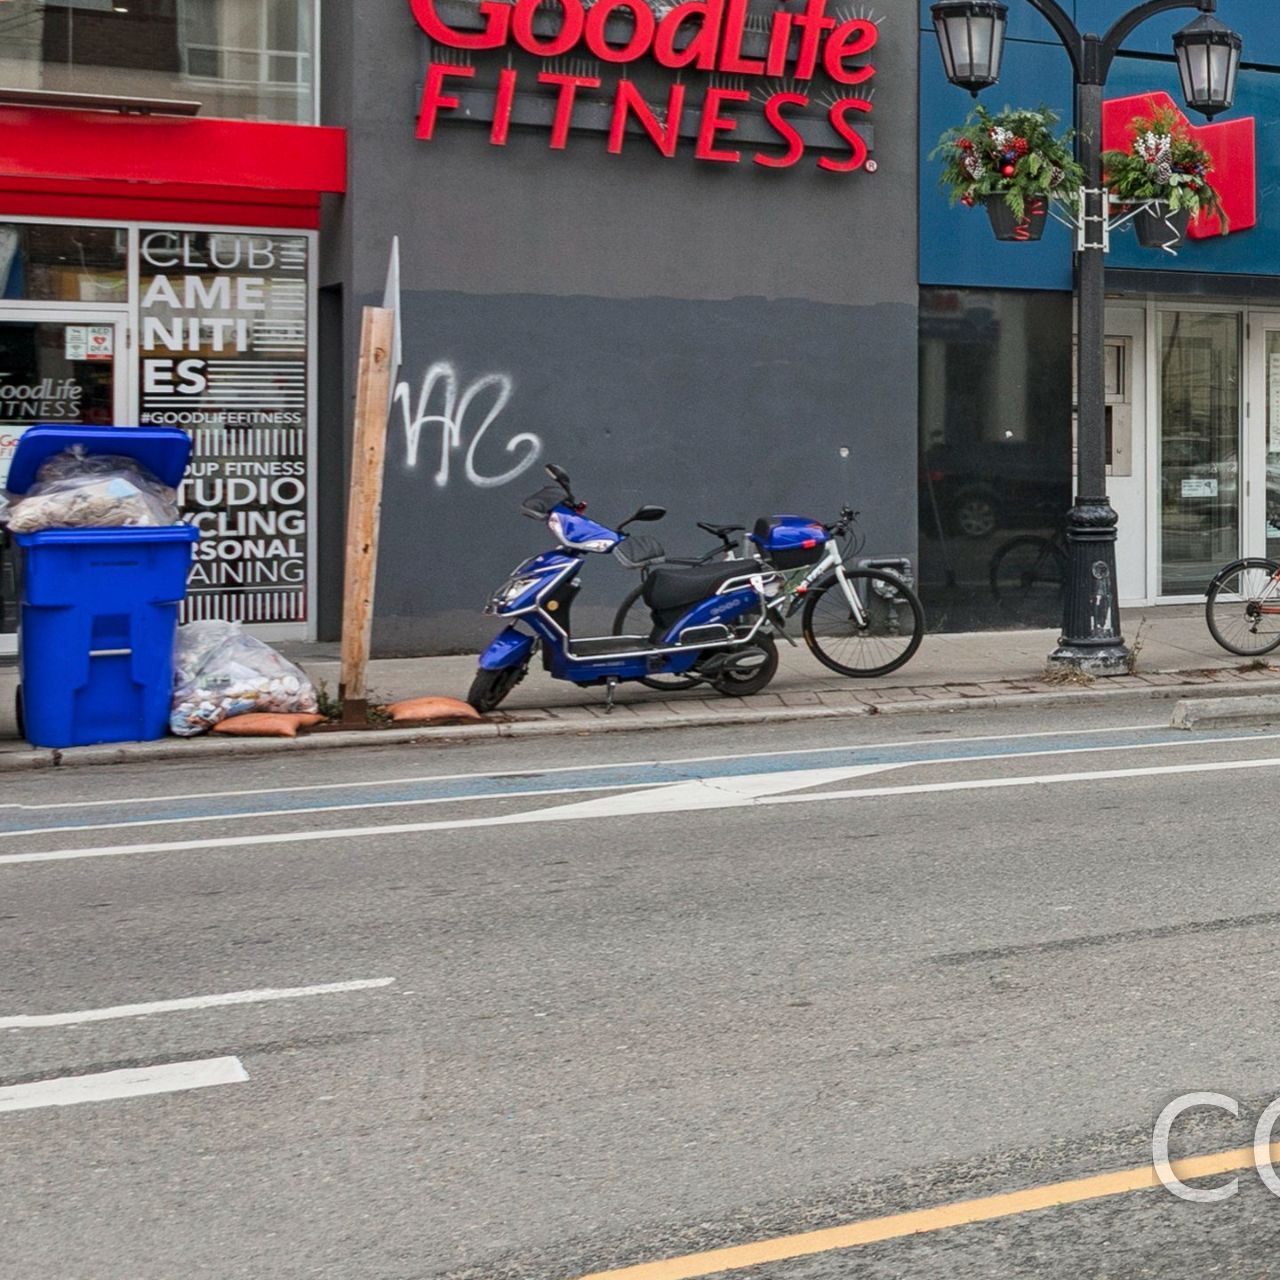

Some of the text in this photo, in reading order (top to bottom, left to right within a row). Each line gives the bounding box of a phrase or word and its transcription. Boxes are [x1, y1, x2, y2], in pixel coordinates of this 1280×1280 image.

[415, 63, 874, 173] FITNESS
[141, 232, 275, 269] CLUB
[141, 275, 265, 311] AME
[144, 317, 248, 352] NITI
[0, 378, 82, 400] oodLife
[143, 359, 207, 394] ES
[0, 401, 81, 417] TNESS
[142, 411, 301, 425] #GOODLIFEFITNESS
[225, 461, 304, 476] FITNESS
[177, 477, 305, 507] TUDIO
[186, 559, 304, 585] AINING
